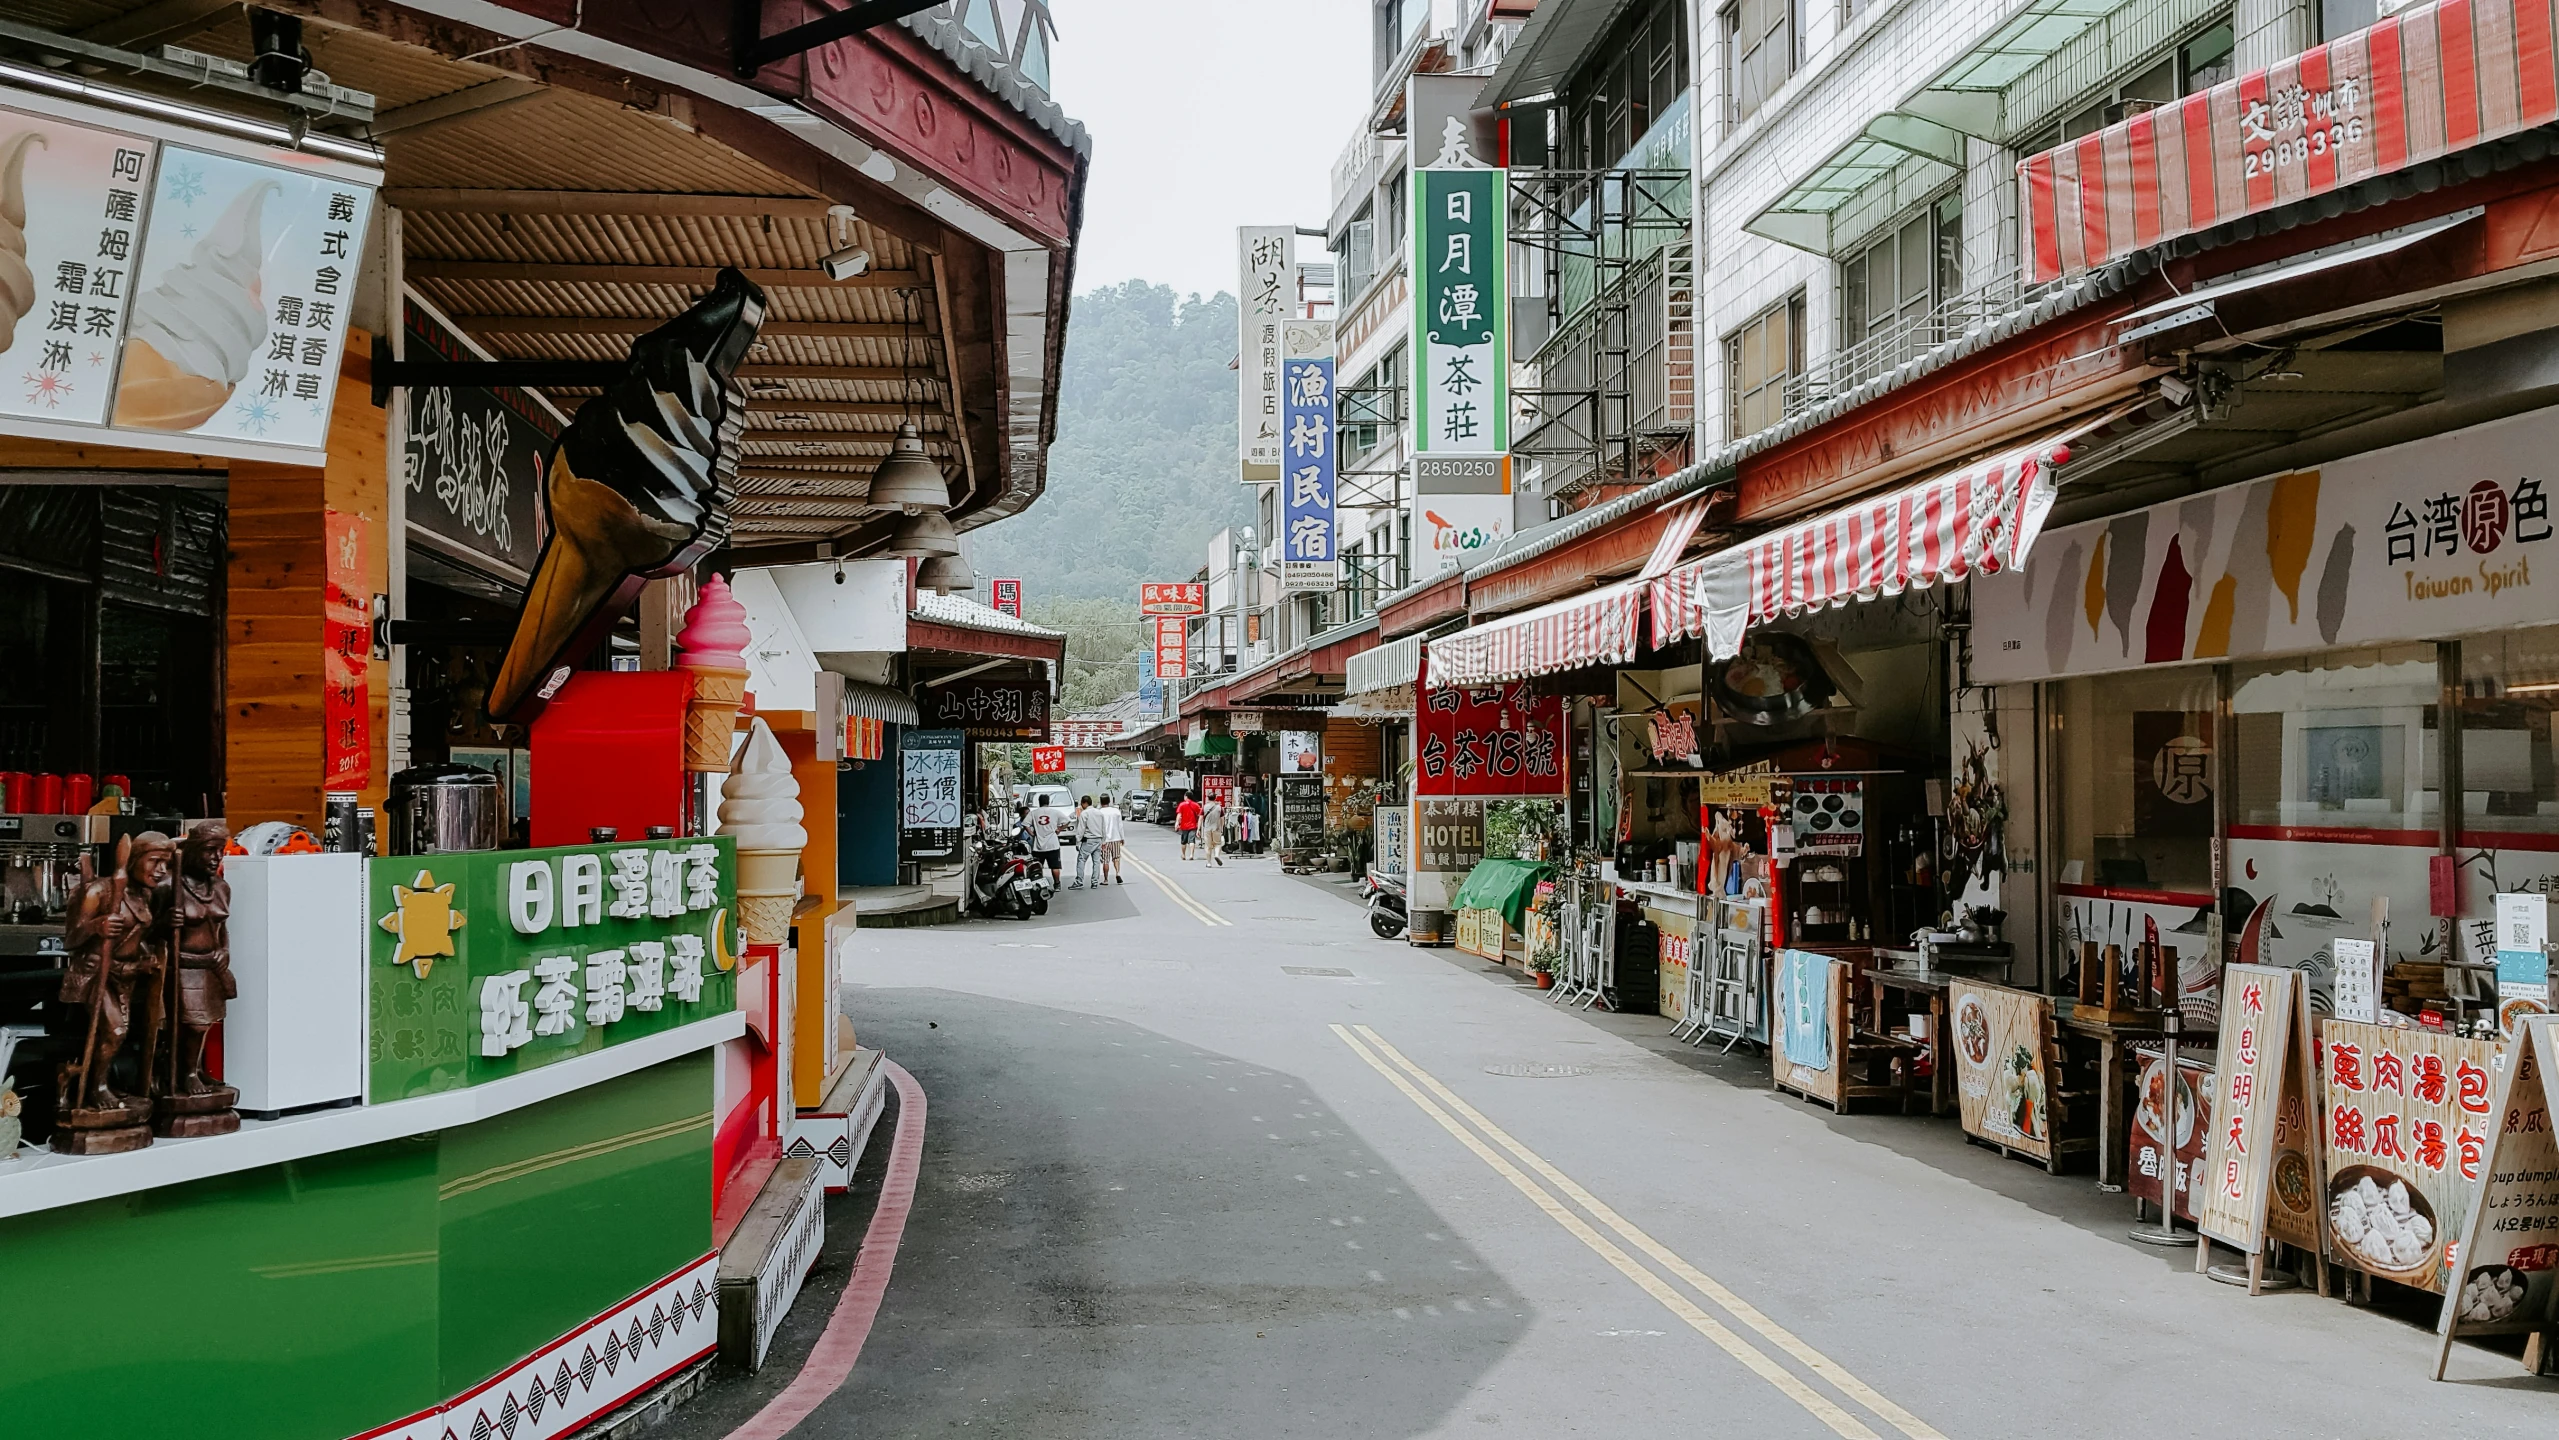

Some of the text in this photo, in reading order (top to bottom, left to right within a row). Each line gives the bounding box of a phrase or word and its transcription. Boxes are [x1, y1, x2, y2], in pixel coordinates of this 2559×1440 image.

[2246, 117, 2362, 178] 2988336
[84, 147, 145, 338] 阿薩姆紅茶
[40, 260, 87, 372] 霜淇淋
[260, 295, 304, 398] 霜淇淋
[1438, 190, 1482, 442] 日月潭 茶莊
[1261, 324, 1275, 415] 渡假旅店
[1289, 363, 1330, 560] 漁村民宿
[1420, 462, 1495, 477] 2850250
[1145, 585, 1202, 602] 風味餐
[2405, 554, 2531, 601] Taiwan Spirit
[905, 776, 957, 801] 特價
[906, 752, 960, 775] 冰棒
[905, 801, 957, 825] $20
[1038, 815, 1050, 826] 3
[1423, 825, 1482, 847] HOTEL
[1424, 800, 1480, 817] 泰湖樓
[509, 844, 720, 934] 日月潭紅茶
[479, 934, 706, 1057] 紅茶霜淇淋
[2222, 983, 2264, 1199] 休息明天見
[2333, 1104, 2485, 1181] 絲瓜湯包
